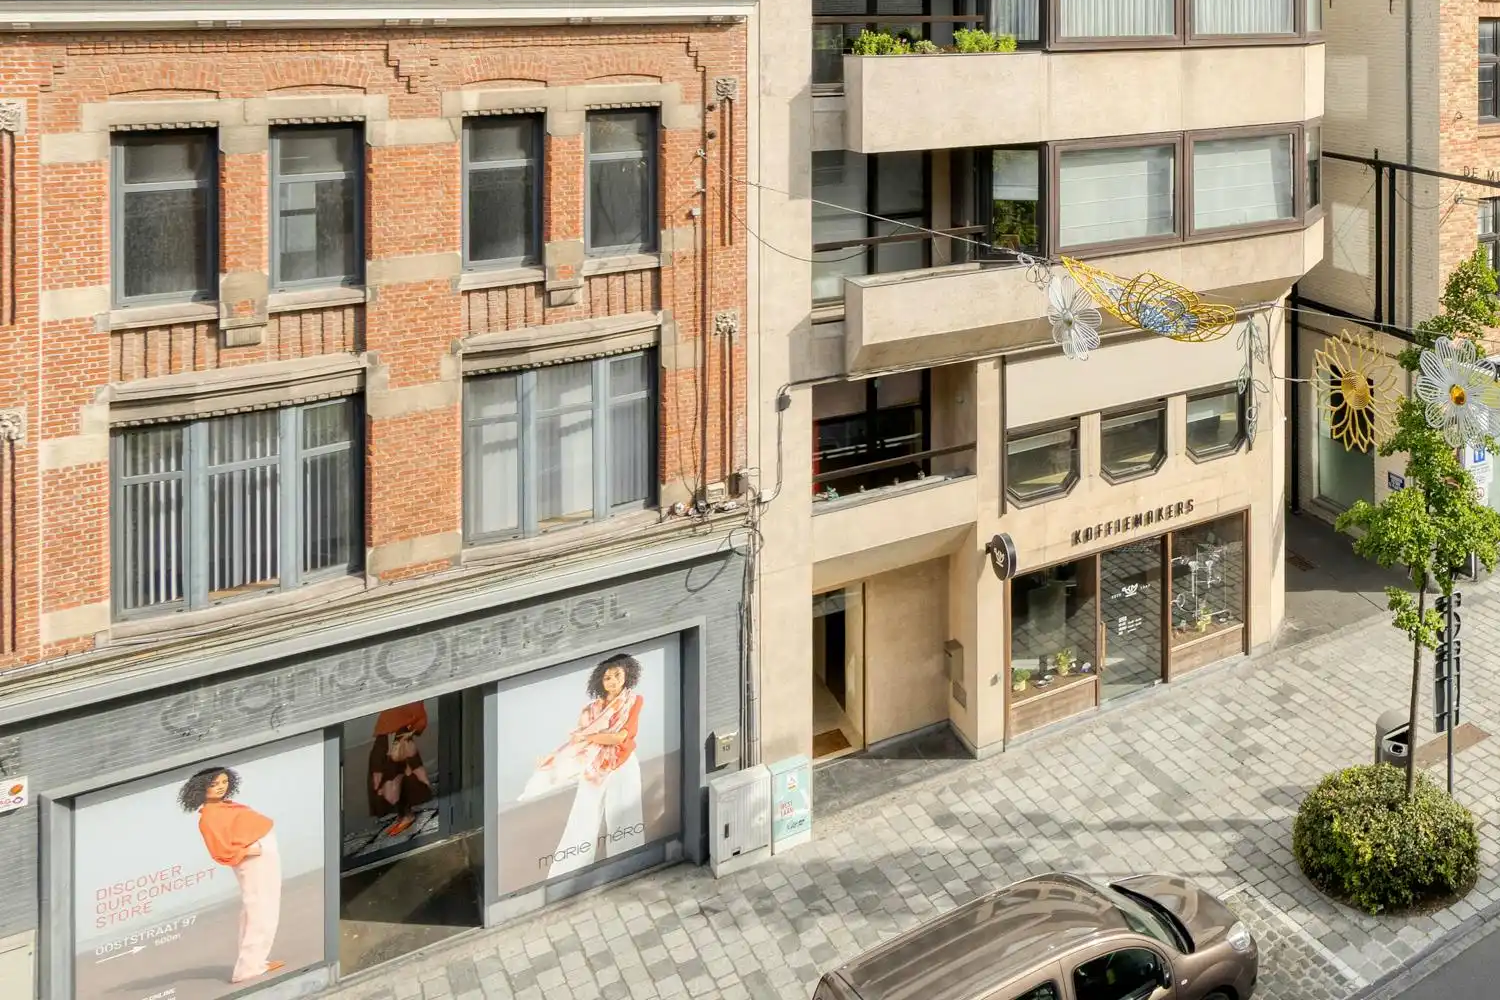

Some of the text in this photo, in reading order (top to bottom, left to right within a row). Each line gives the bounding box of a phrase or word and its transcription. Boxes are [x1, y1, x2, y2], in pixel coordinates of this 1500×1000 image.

[1463, 165, 1479, 179] DE
[1071, 498, 1195, 547] KOFFIEMAKERS
[96, 865, 182, 901] DISCOVER
[96, 867, 217, 915] OUR CONCEPT
[96, 901, 153, 929] STORE
[95, 921, 179, 956] OOSTSTRAAT
